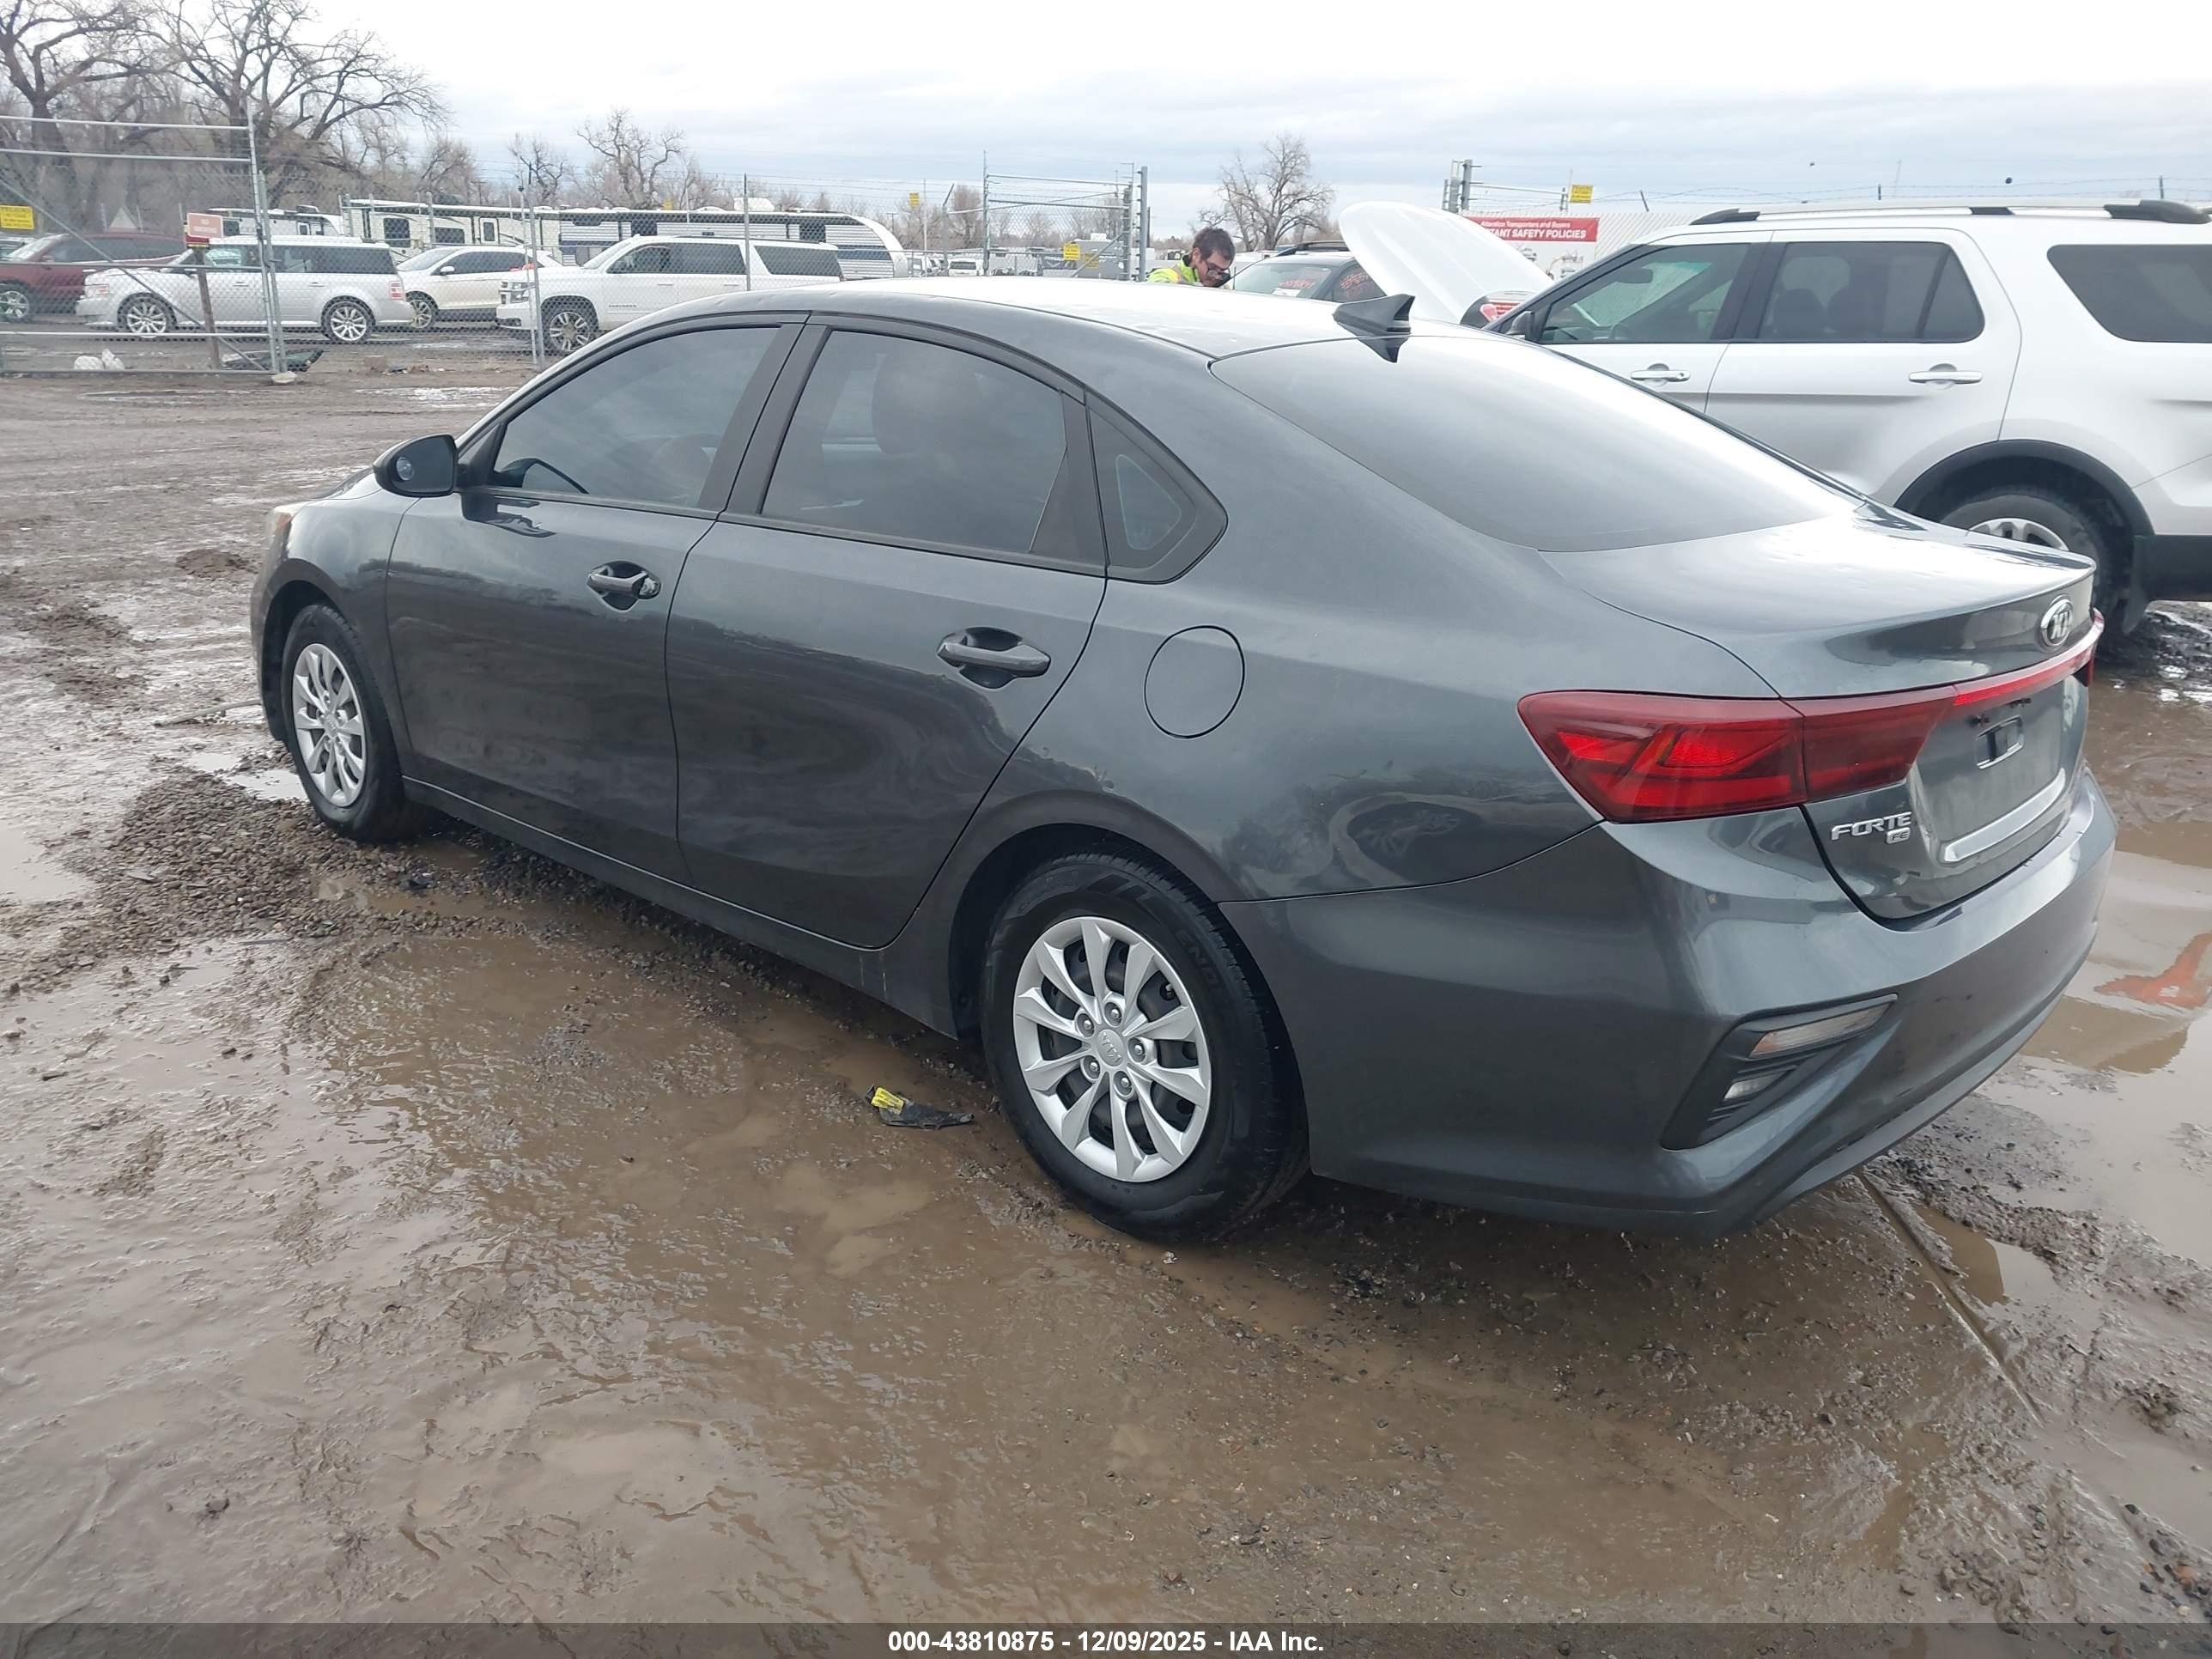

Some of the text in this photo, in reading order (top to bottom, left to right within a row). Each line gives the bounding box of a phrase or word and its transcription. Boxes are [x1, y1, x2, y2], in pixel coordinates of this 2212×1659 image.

[1512, 228, 1545, 239] SAFETY
[1546, 229, 1587, 240] POLICIES
[1831, 811, 1912, 841] FORTE
